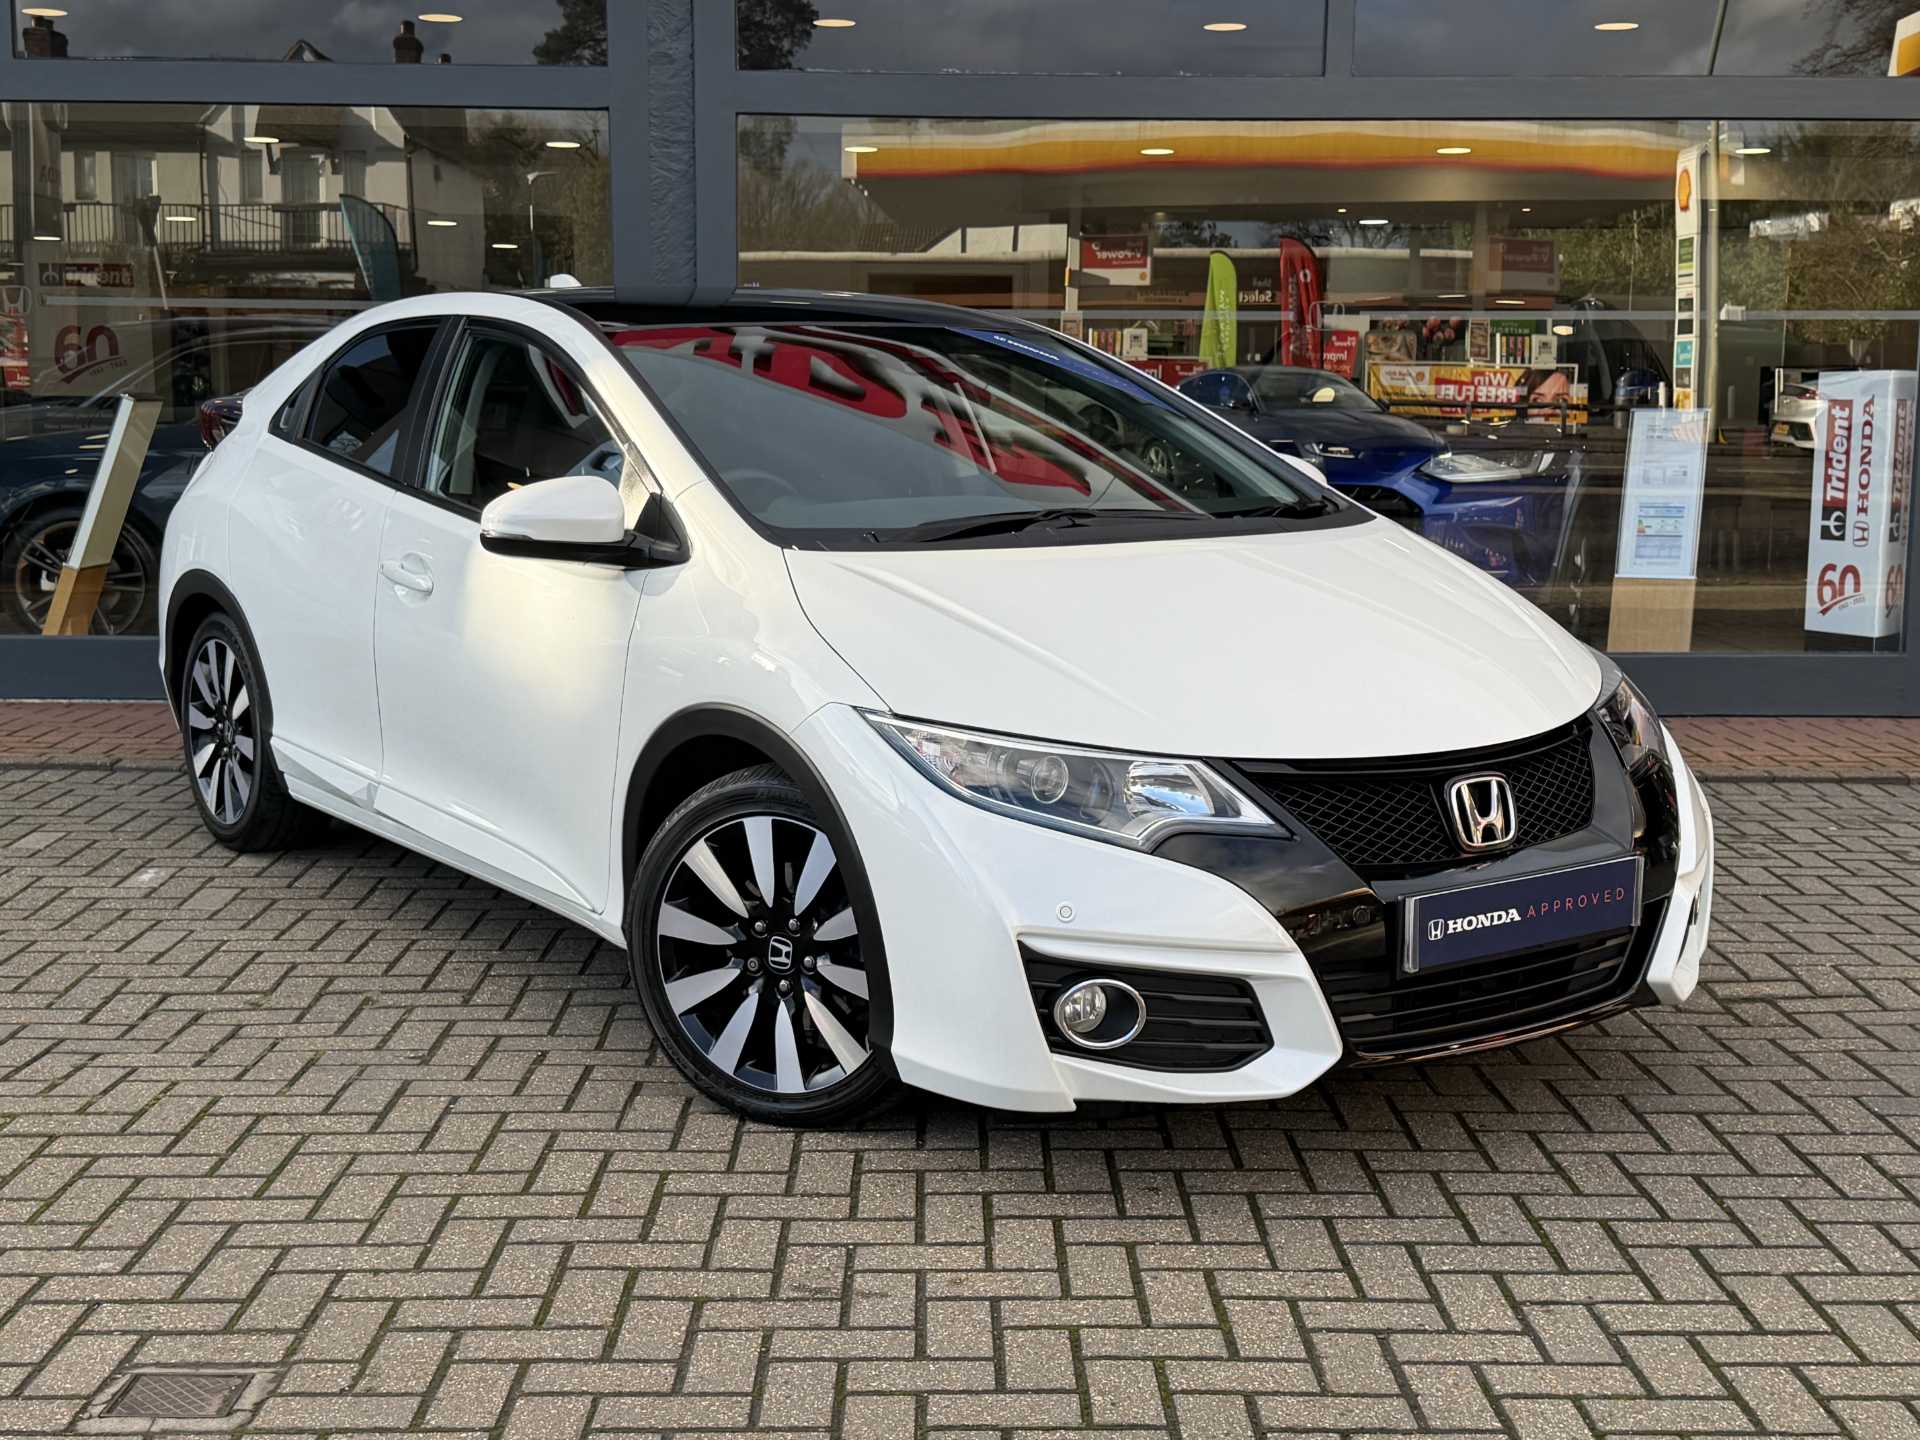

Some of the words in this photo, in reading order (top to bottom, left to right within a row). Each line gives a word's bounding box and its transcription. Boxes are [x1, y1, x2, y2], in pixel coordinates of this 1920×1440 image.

[65, 264, 132, 287] Tdent
[1826, 405, 1852, 502] Trident
[1856, 394, 1876, 516] HONDA
[1817, 563, 1861, 607] 60
[1446, 908, 1521, 934] HONDA
[1526, 887, 1625, 918] APPROVED
